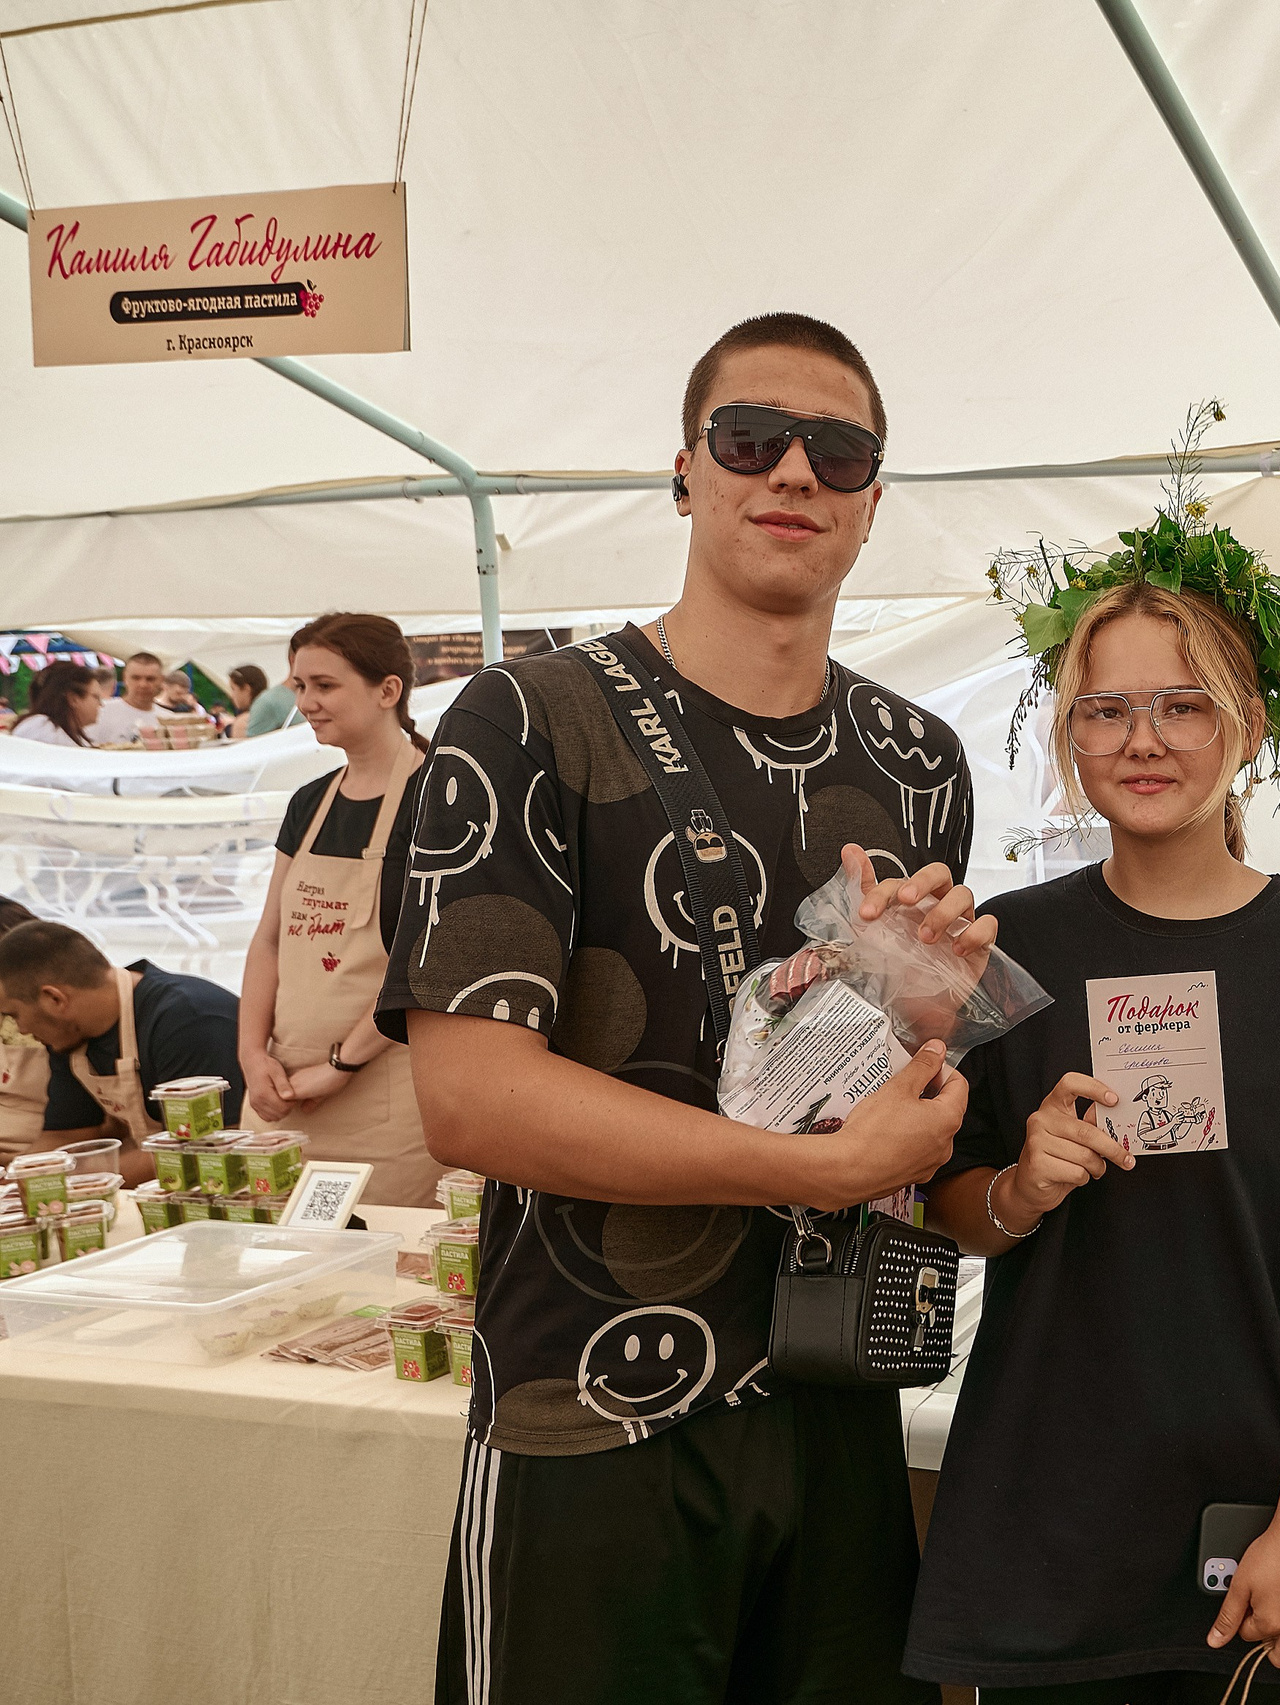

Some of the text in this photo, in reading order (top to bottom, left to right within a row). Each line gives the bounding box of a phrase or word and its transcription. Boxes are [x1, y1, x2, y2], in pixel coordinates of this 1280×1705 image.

[47, 214, 382, 283] Камиля Габидулина
[121, 291, 298, 317] Фруктово-ягодная пастила
[167, 333, 253, 353] г. Красноярск
[631, 708, 689, 774] KARL
[288, 913, 345, 941] не брат
[1107, 994, 1200, 1025] Подарок
[1117, 1020, 1191, 1035] от фермера
[850, 1049, 858, 1058] ИЗ
[823, 1056, 851, 1086] ОЛЕНИНЫ
[440, 1249, 469, 1259] ПАСТИЛА
[395, 1337, 422, 1347] ПАСТИЛА
[453, 1342, 472, 1350] ПАСТИ
